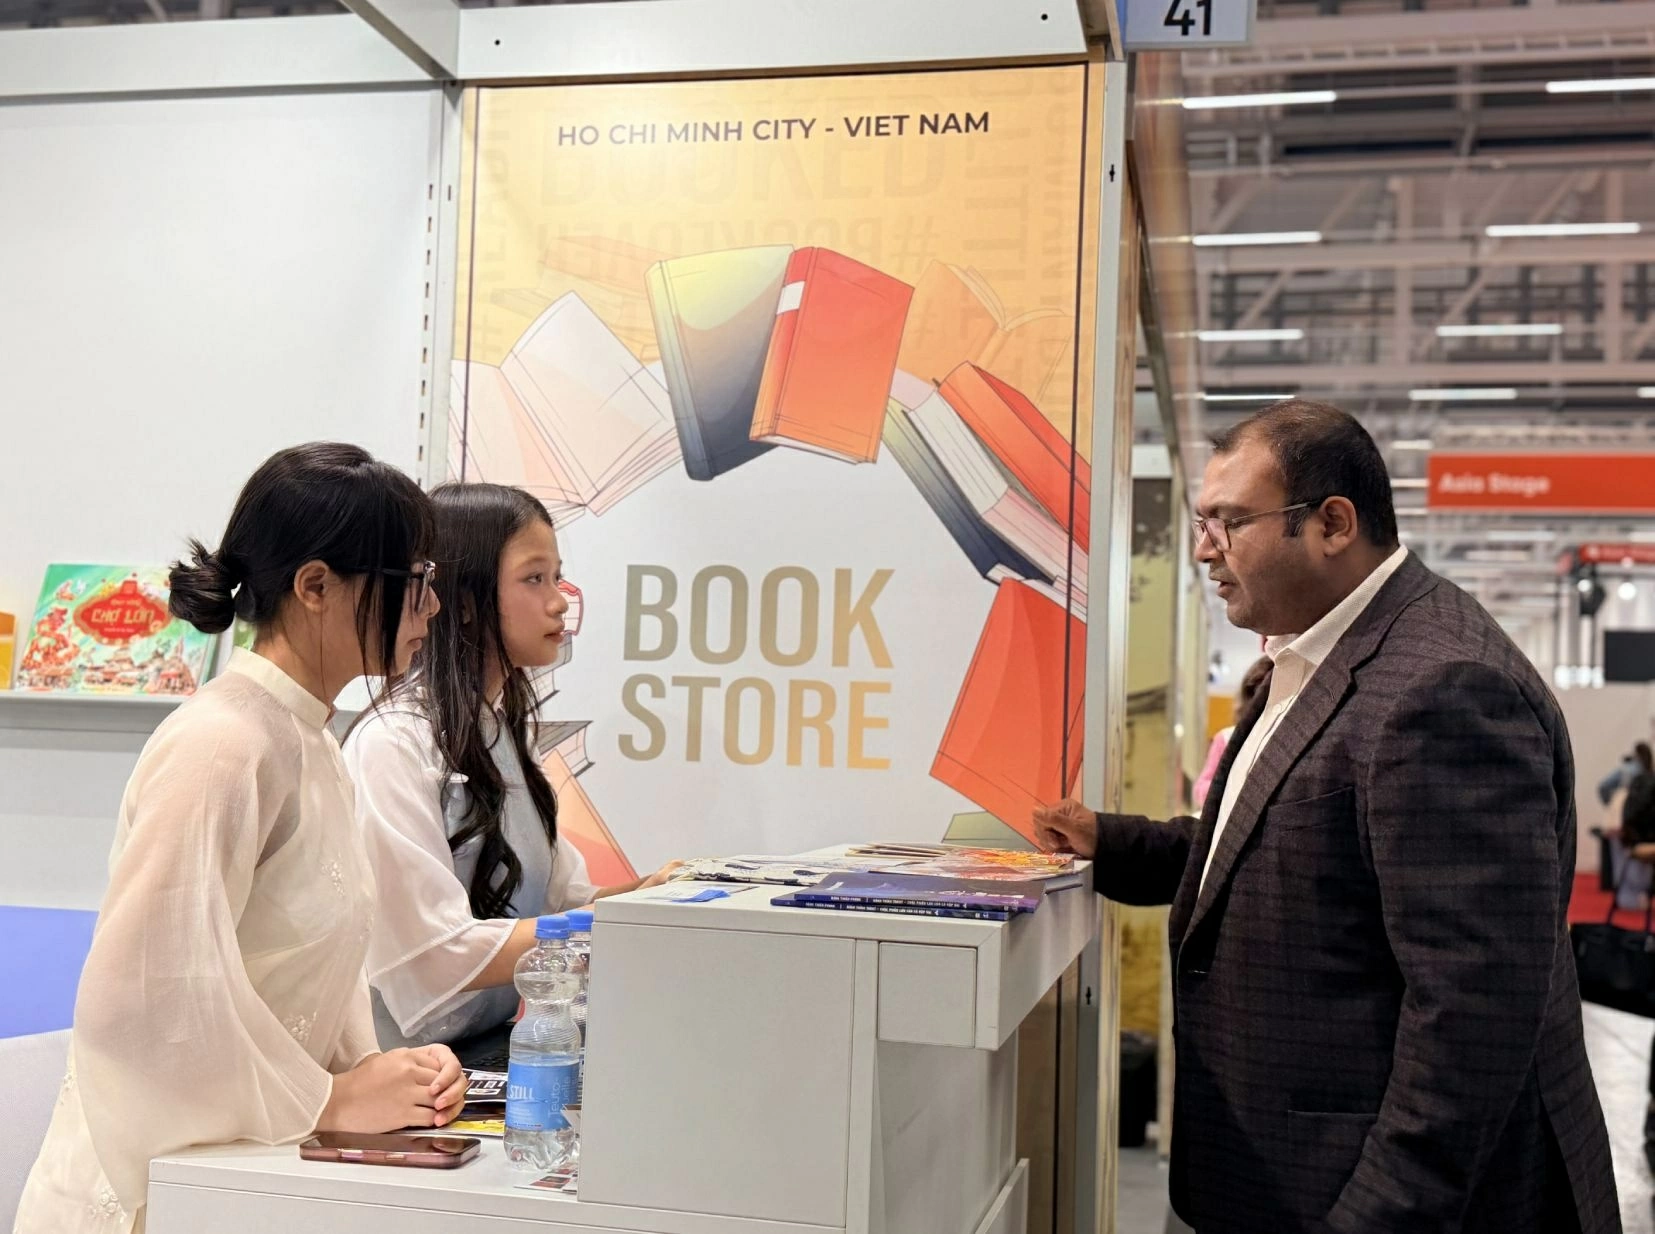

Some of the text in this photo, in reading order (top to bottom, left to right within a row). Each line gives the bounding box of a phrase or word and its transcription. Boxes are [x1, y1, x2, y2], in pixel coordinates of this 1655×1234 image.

[1163, 0, 1213, 36] 41
[558, 125, 599, 148] HO
[609, 123, 656, 146] CHI
[667, 120, 743, 144] MINH
[752, 117, 817, 142] CITY
[843, 114, 911, 139] VIET
[918, 111, 990, 137] NAM
[1438, 472, 1551, 498] Asia Stage
[623, 564, 896, 669] BOOK
[617, 673, 893, 770] STORE
[509, 1085, 534, 1100] STILL
